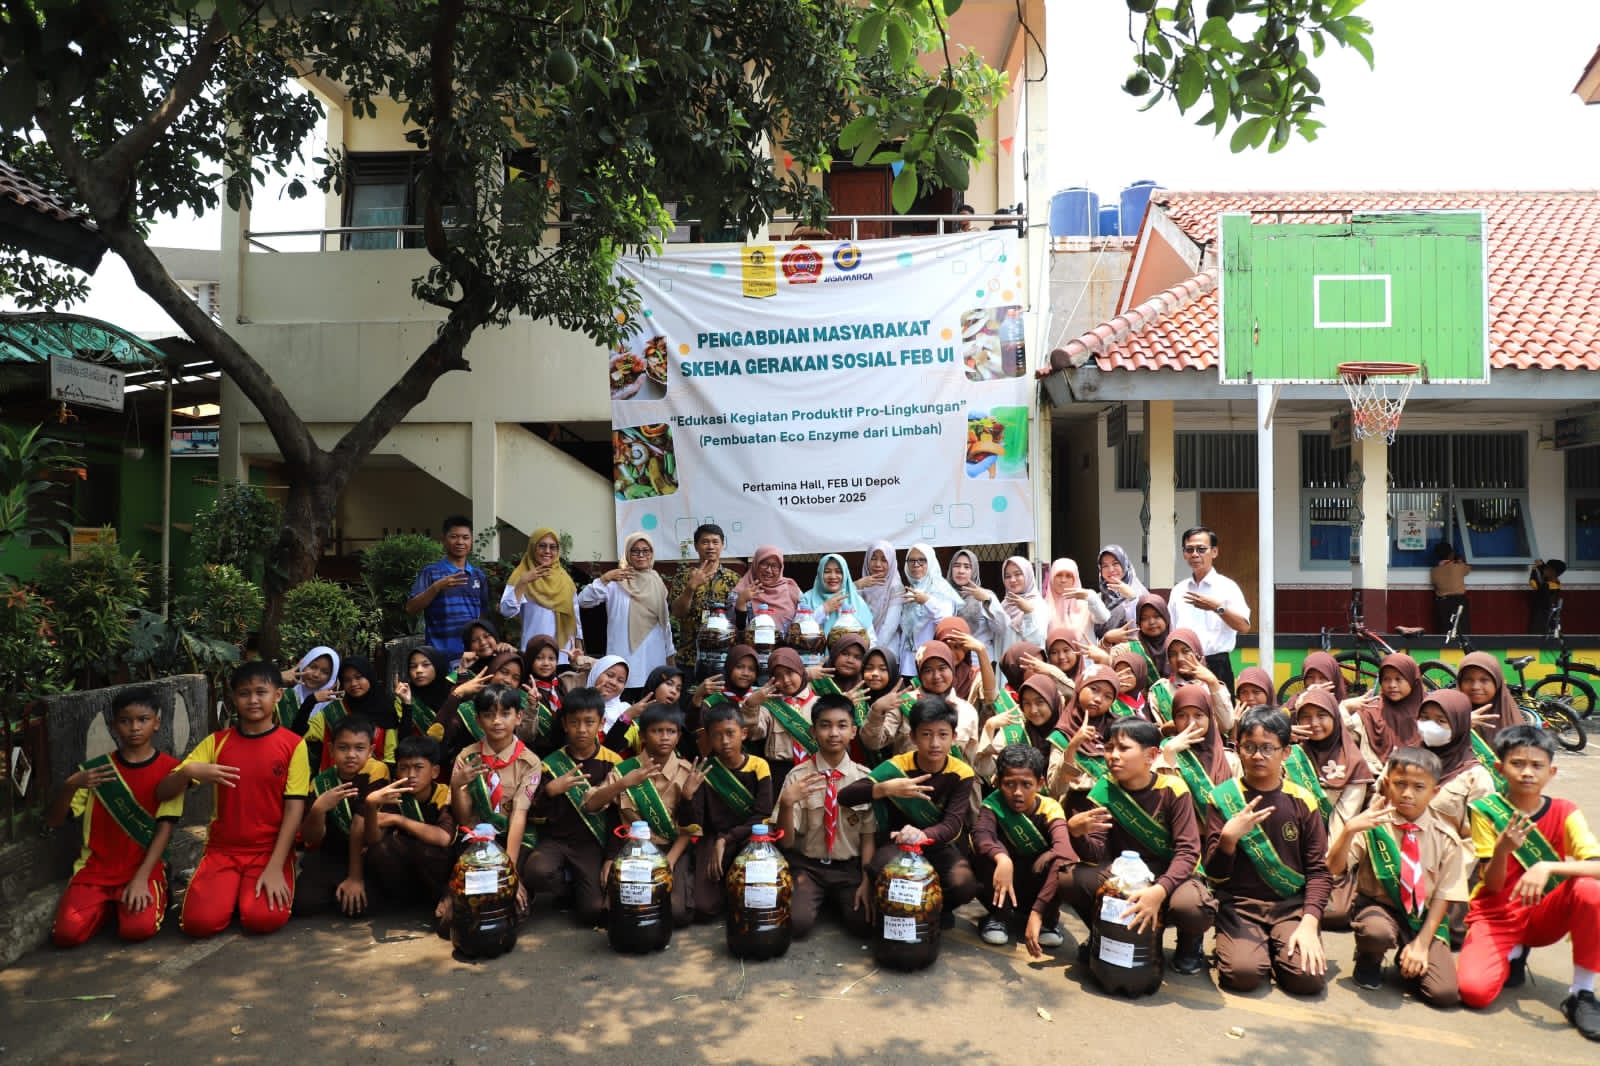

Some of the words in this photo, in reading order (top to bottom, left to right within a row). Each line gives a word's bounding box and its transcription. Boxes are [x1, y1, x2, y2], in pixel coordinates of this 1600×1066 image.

[823, 272, 874, 283] JASAMARGA
[697, 327, 809, 349] PENGABDIAN
[813, 320, 931, 342] MASYARAKAT
[680, 360, 742, 377] SKEMA
[745, 354, 829, 374] GERAKAN
[832, 351, 897, 369] SOSIAL
[900, 348, 933, 365] FEB
[937, 346, 955, 362] UI
[730, 410, 788, 424] Kegiatan
[792, 407, 853, 421] Produktif
[700, 433, 776, 448] (Pembuatan
[780, 431, 805, 442] Eco
[808, 430, 859, 442] Enzyme
[863, 427, 888, 438] dari
[892, 422, 942, 437] Limbah)
[742, 481, 797, 493] Pertamina
[800, 480, 825, 490] Hall,
[827, 479, 848, 489] FEB
[851, 477, 863, 487] UI
[865, 476, 900, 488] Depok
[778, 496, 788, 506] 11
[791, 494, 835, 505] Oktober
[839, 493, 867, 503] 2025
